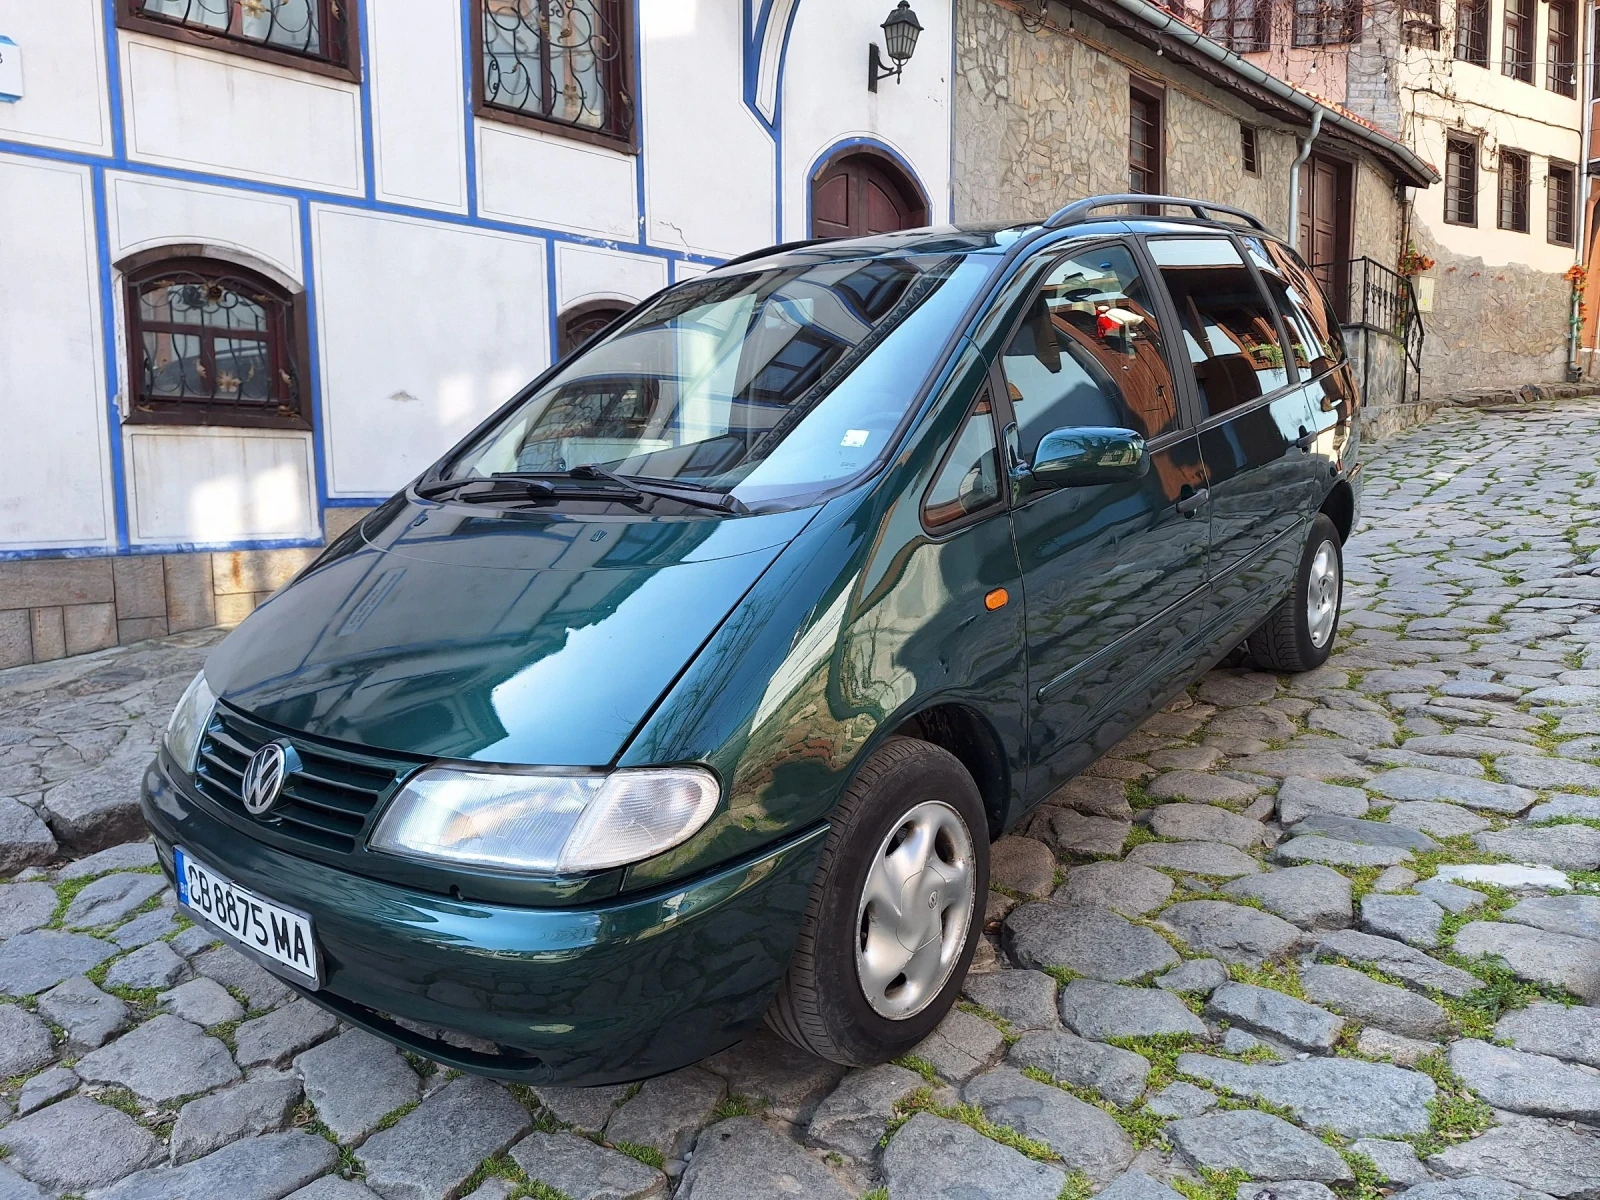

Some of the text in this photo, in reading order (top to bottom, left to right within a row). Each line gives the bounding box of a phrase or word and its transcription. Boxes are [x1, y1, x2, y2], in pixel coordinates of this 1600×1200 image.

[243, 745, 284, 813] VW
[188, 864, 310, 969] CB 8875 MA
